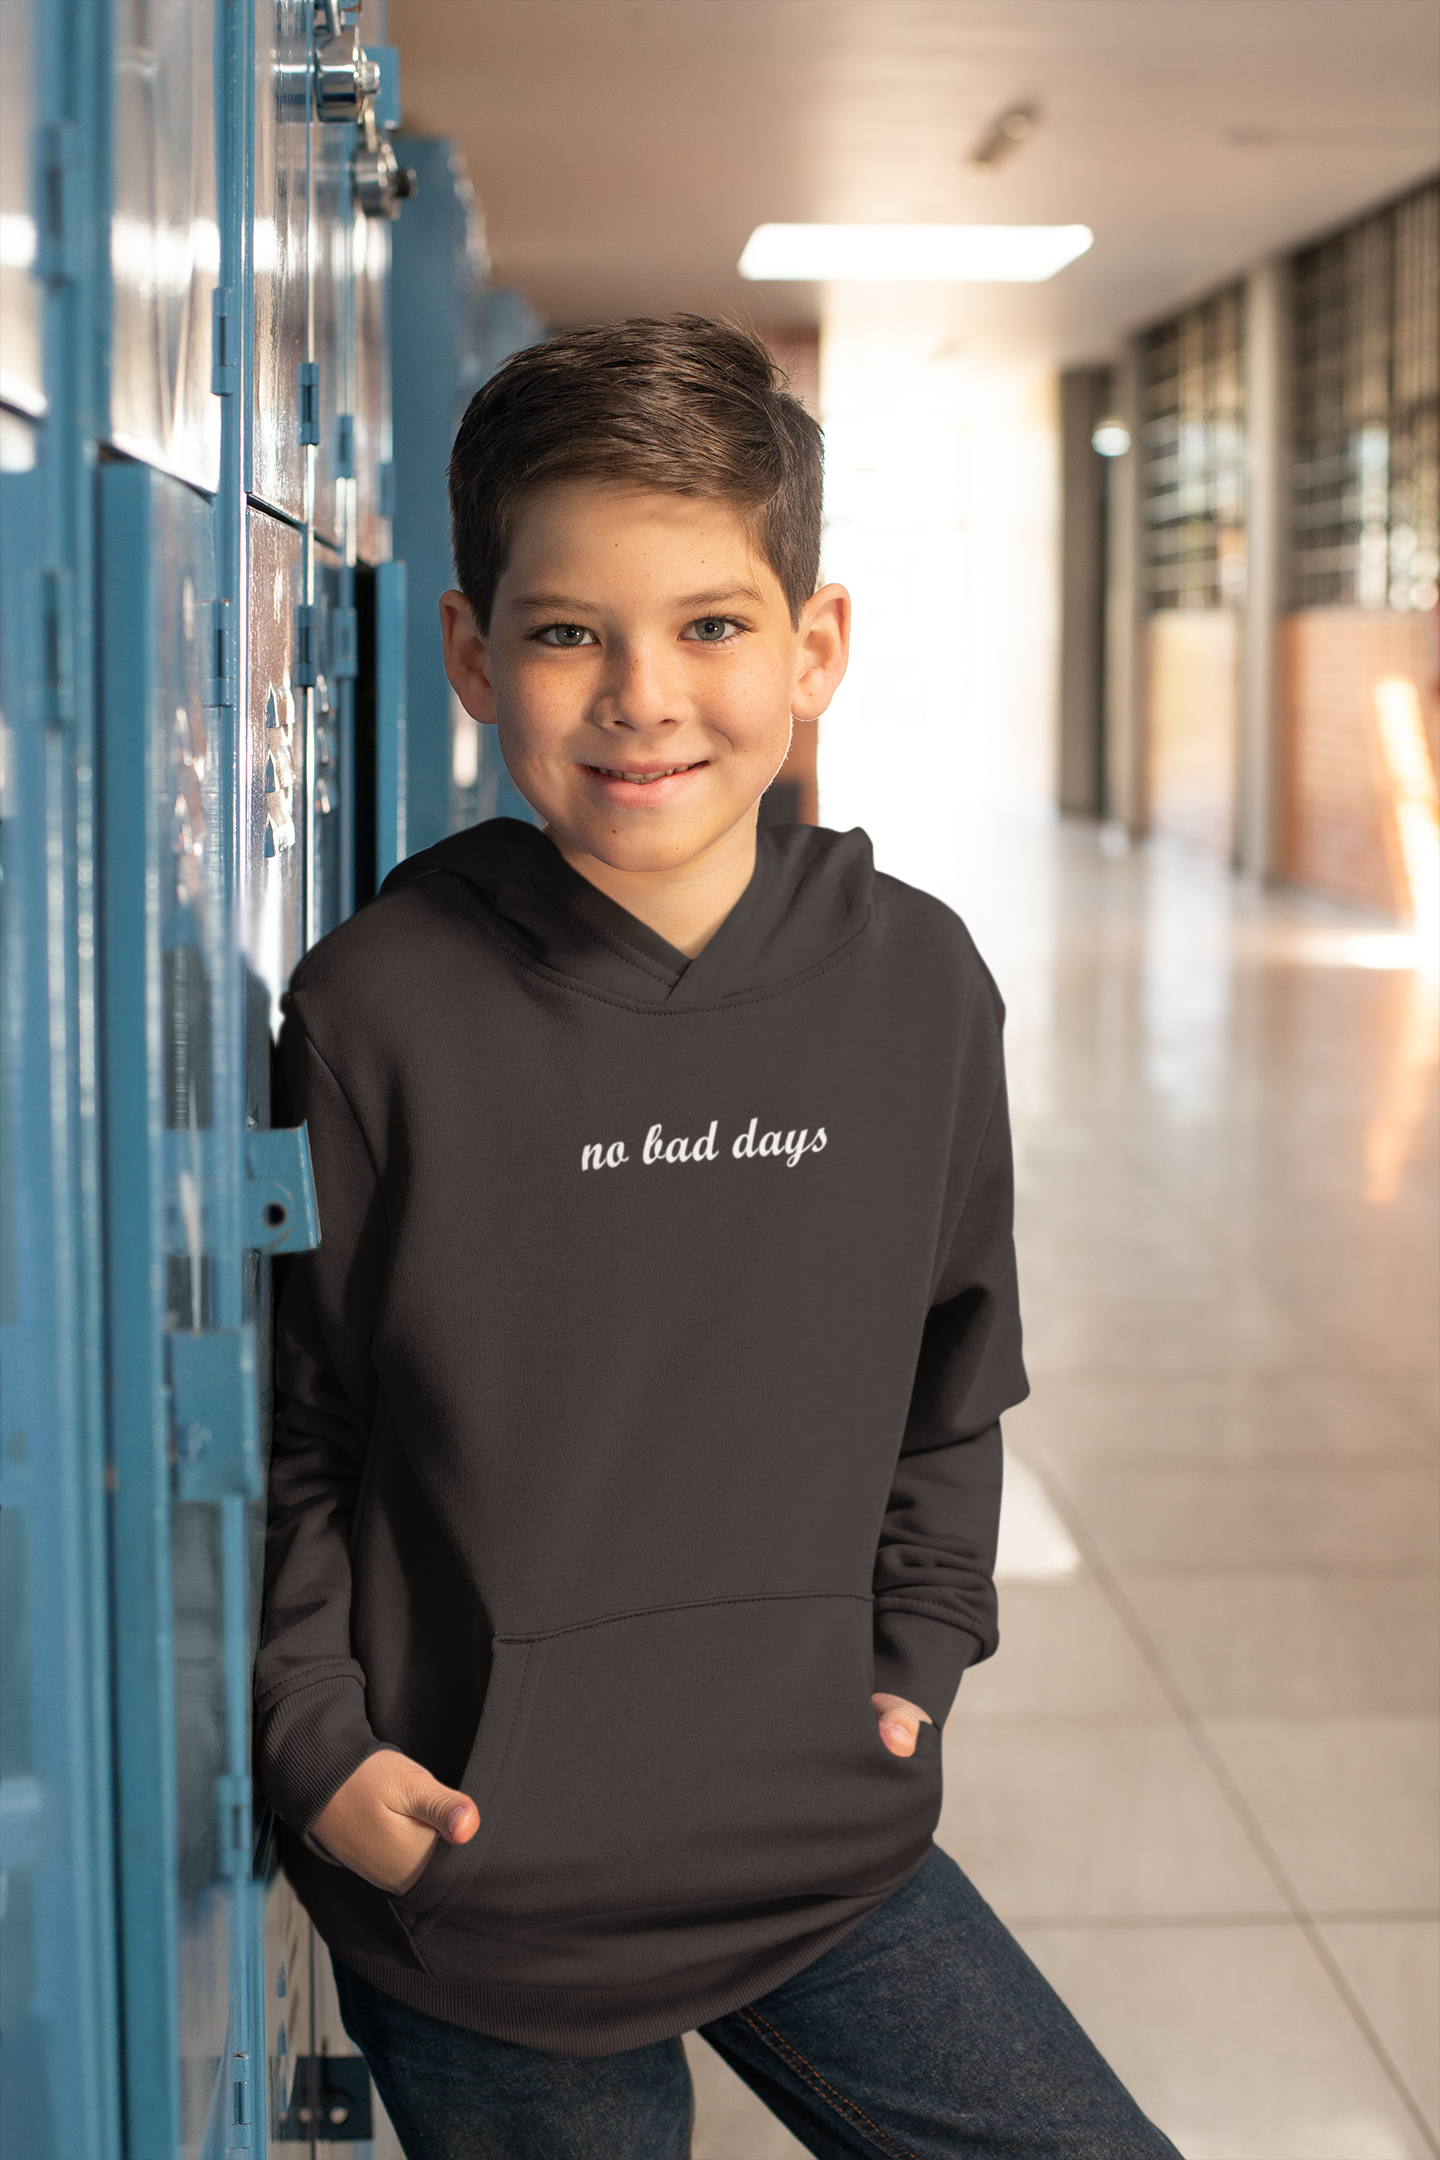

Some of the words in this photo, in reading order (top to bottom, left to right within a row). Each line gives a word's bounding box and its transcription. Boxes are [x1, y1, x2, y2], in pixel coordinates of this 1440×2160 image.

[581, 1141, 629, 1172] no
[642, 1120, 719, 1165] bad
[732, 1117, 828, 1168] days
